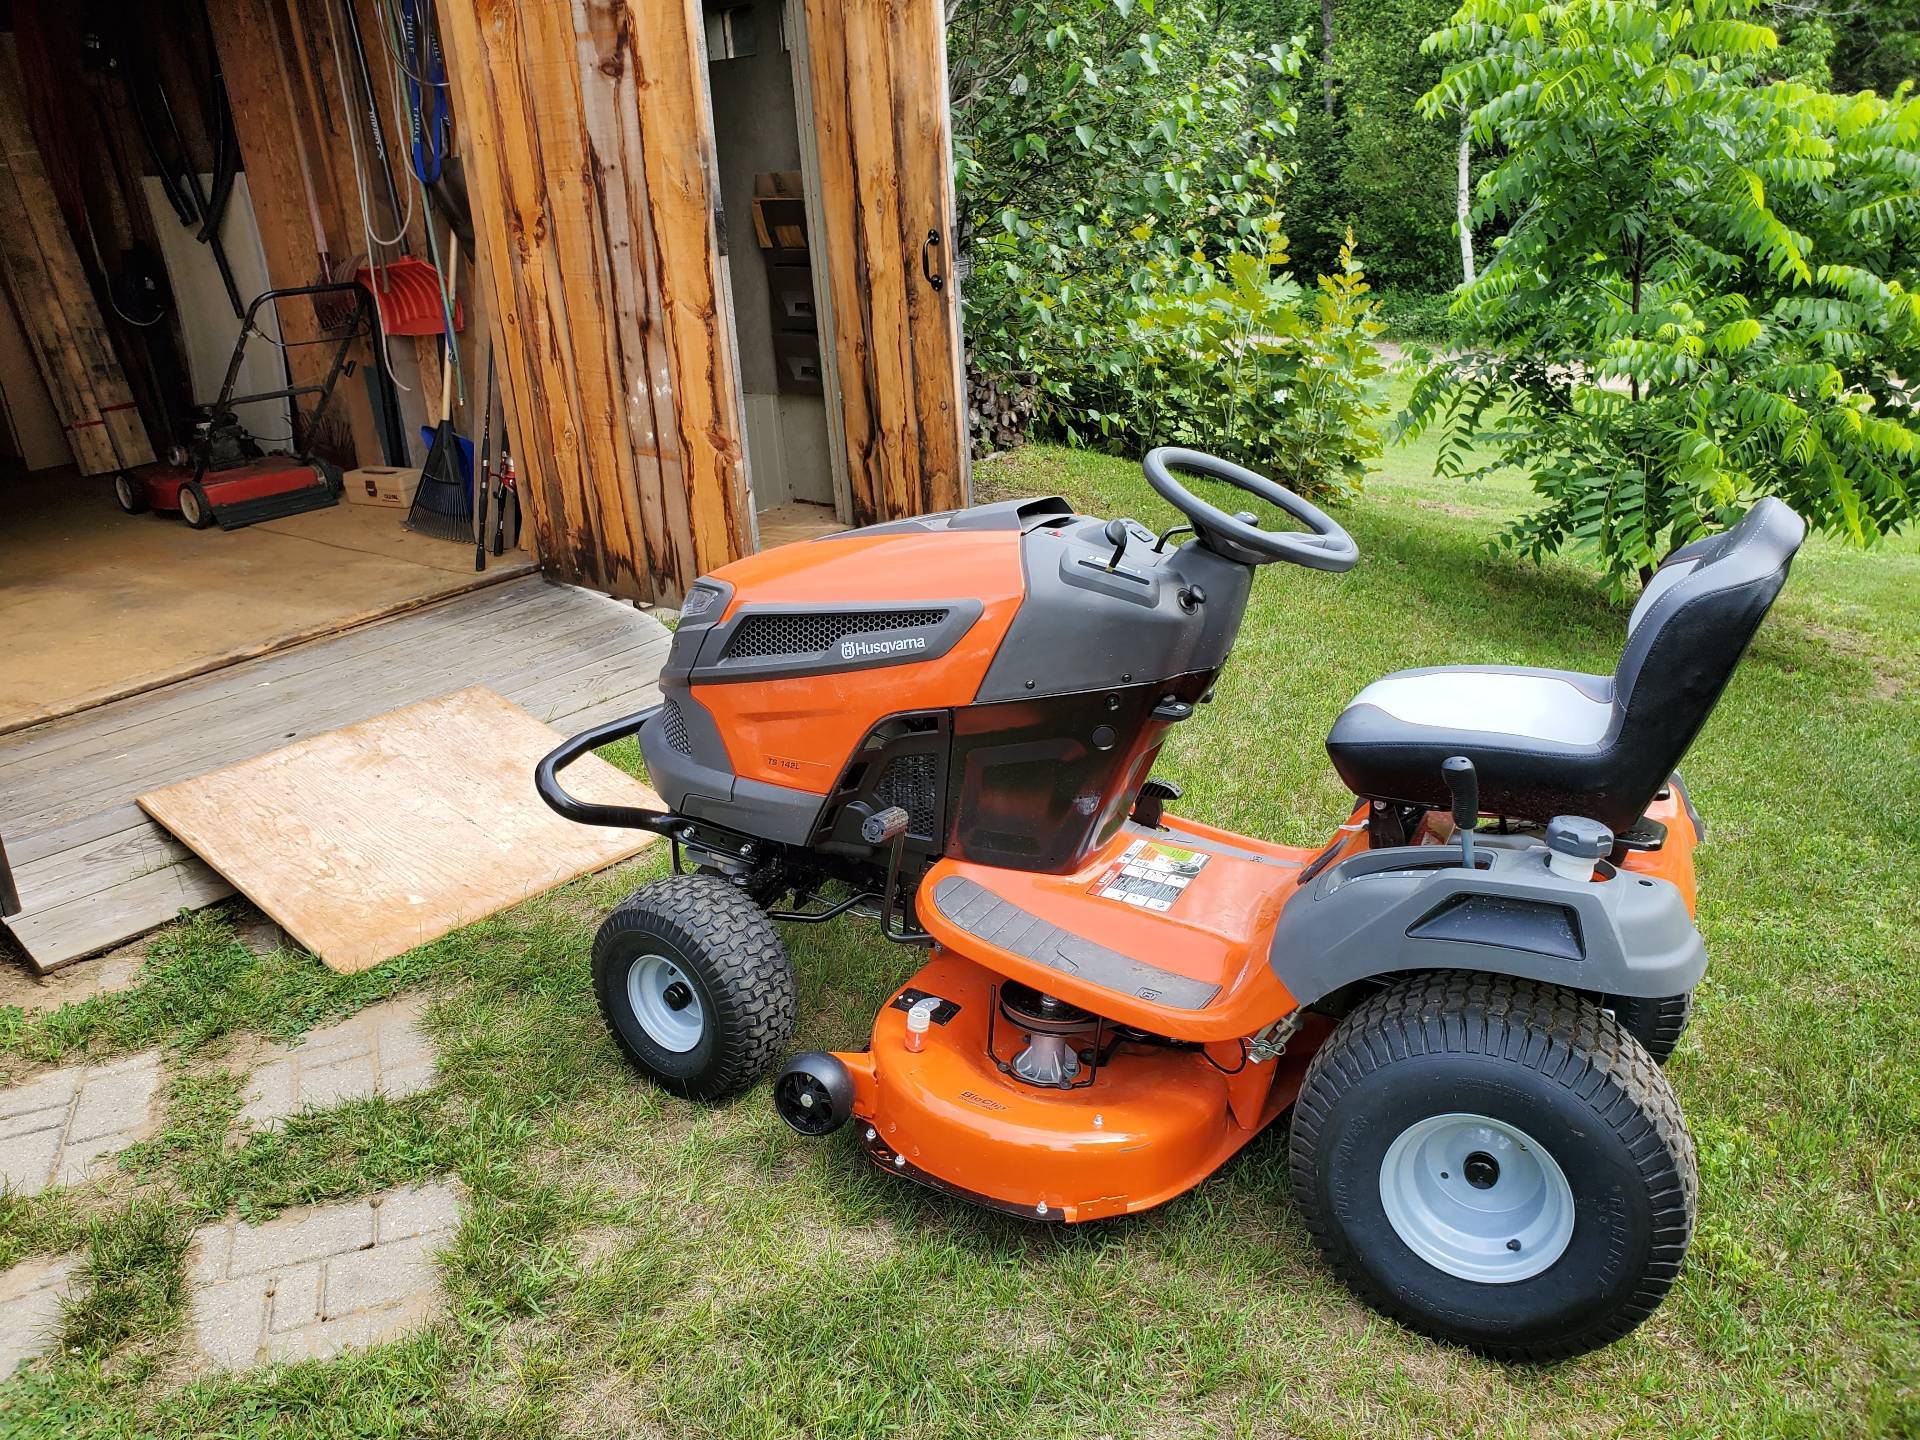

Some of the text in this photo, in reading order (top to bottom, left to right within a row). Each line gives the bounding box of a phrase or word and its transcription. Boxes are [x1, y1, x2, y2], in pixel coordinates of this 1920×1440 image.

[406, 13, 415, 54] THULE
[413, 105, 421, 144] THULE
[855, 637, 926, 656] Husqvarna
[780, 760, 800, 770] 142L
